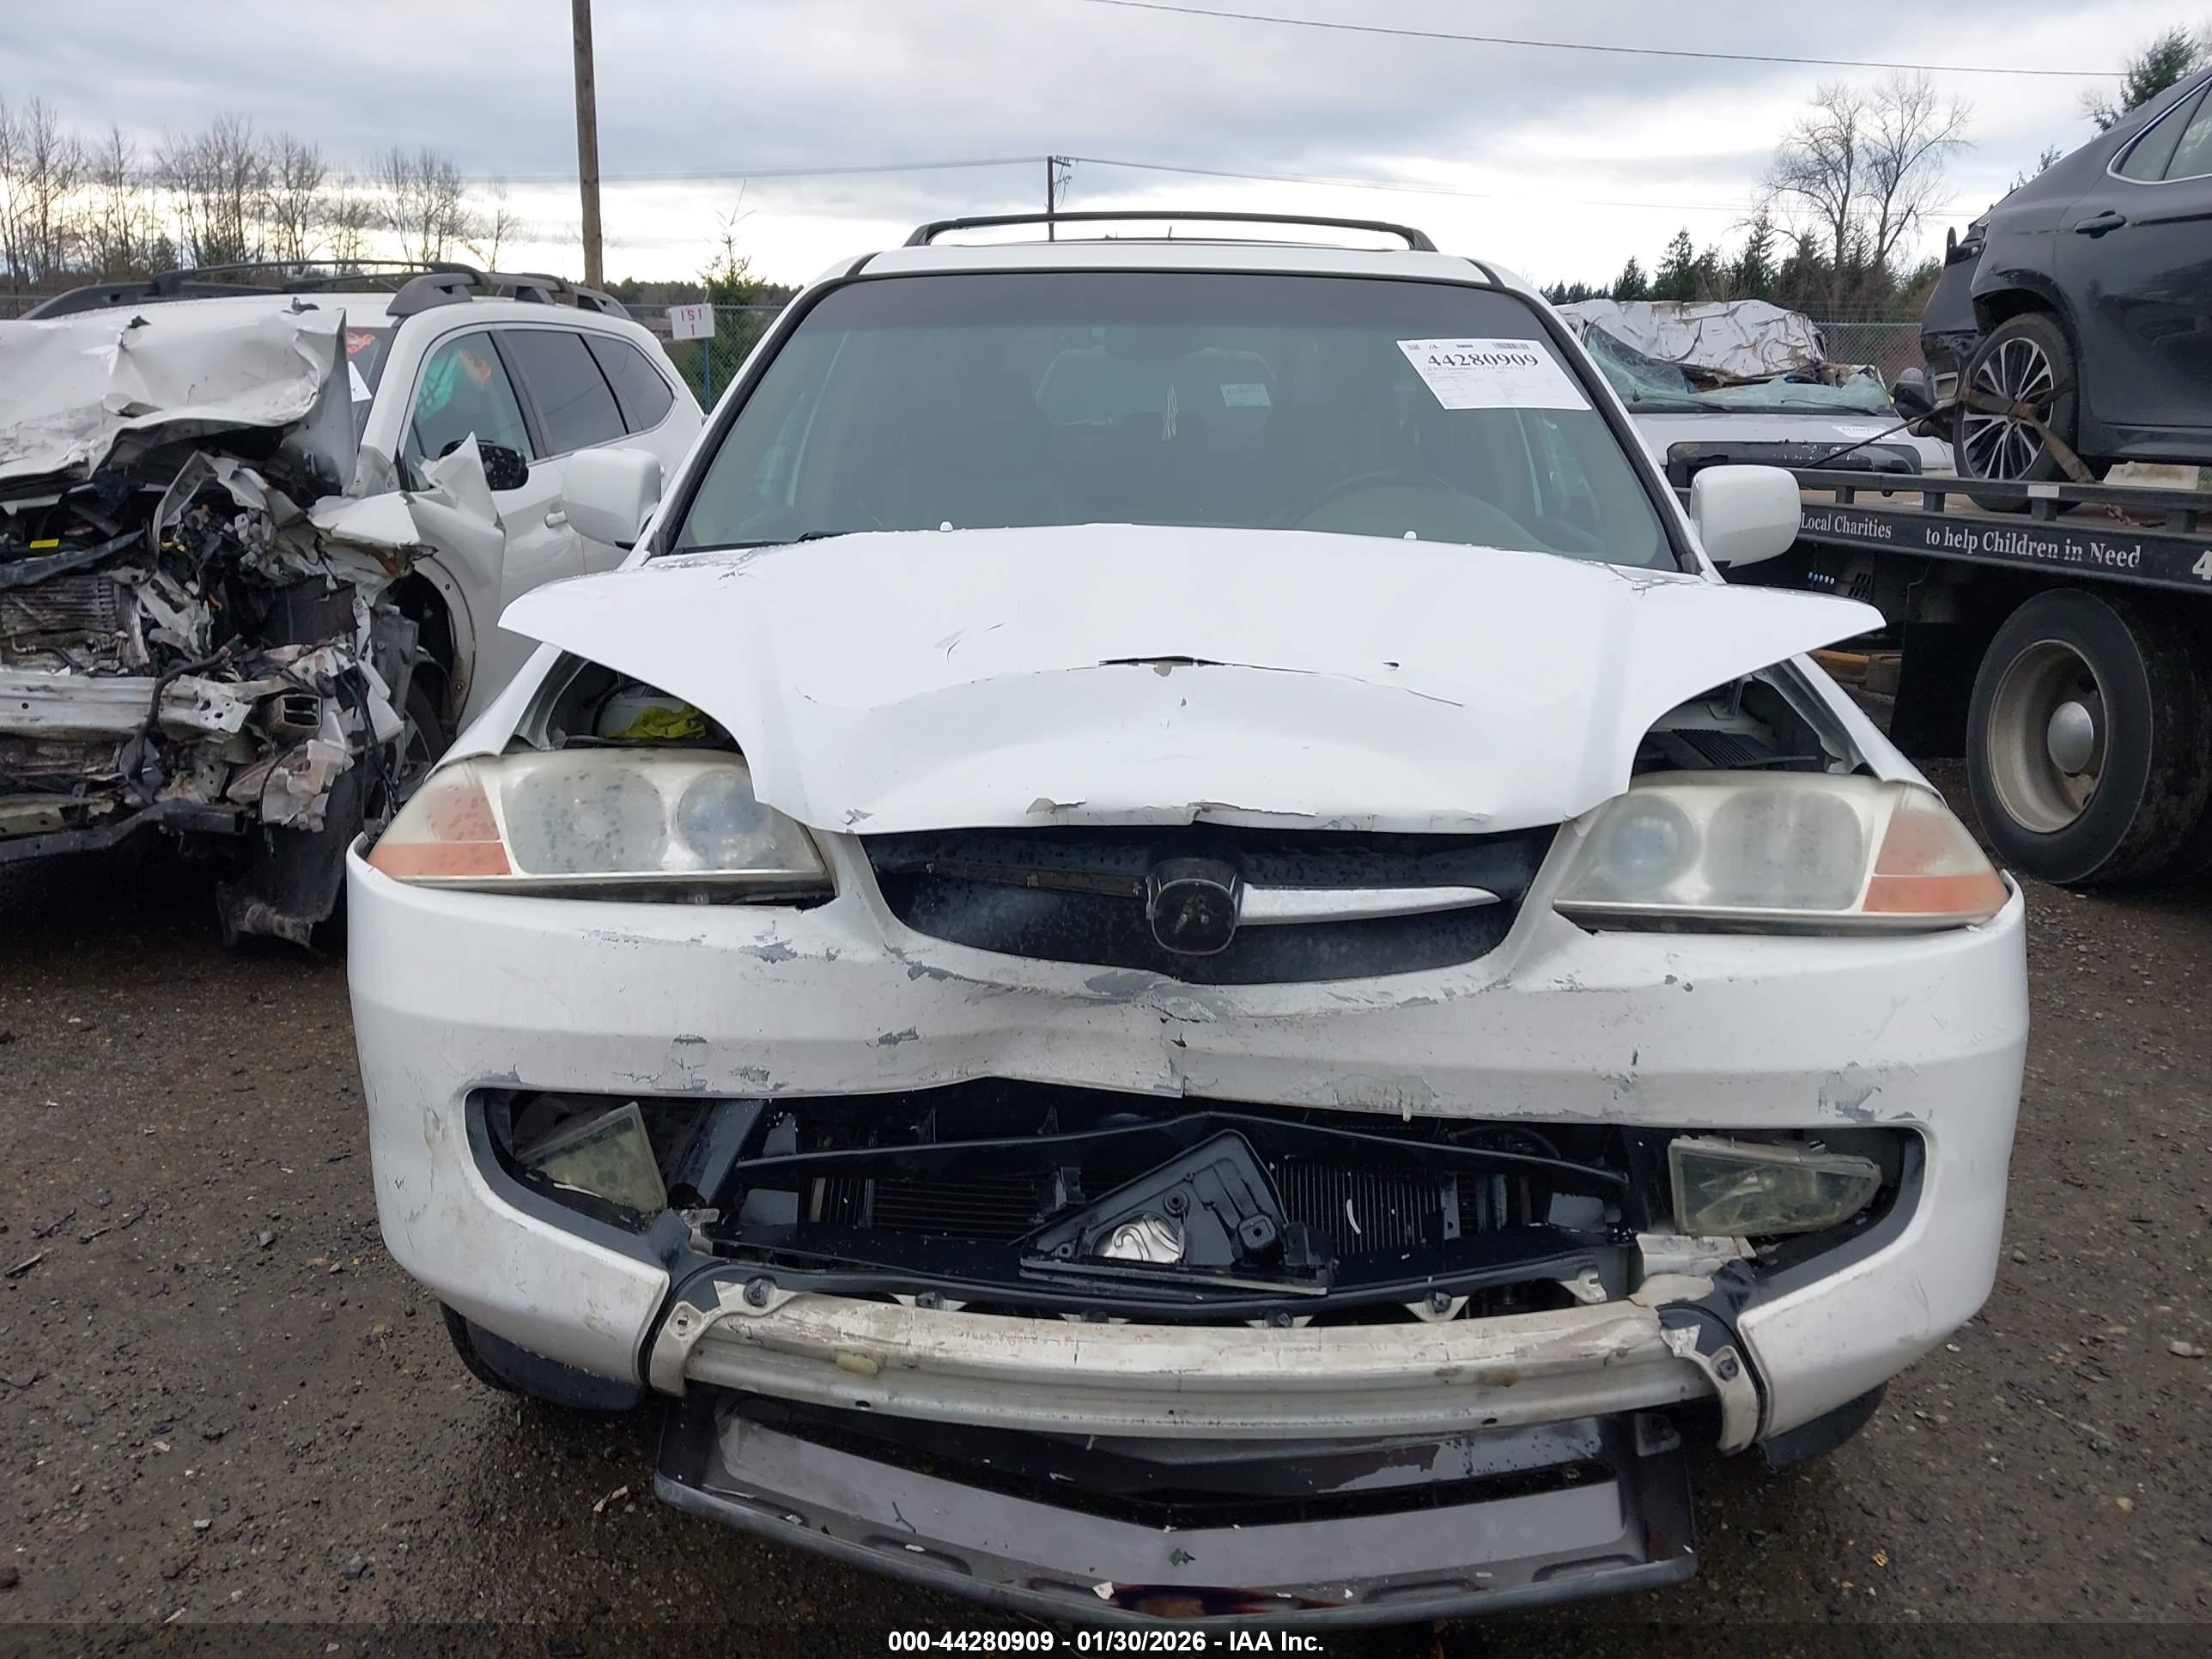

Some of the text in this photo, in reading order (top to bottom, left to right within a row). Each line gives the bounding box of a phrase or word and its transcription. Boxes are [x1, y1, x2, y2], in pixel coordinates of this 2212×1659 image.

[1428, 352, 1539, 367] 44280909
[1801, 512, 1892, 539] Local Charities
[1925, 526, 2142, 568] to help Children in Need
